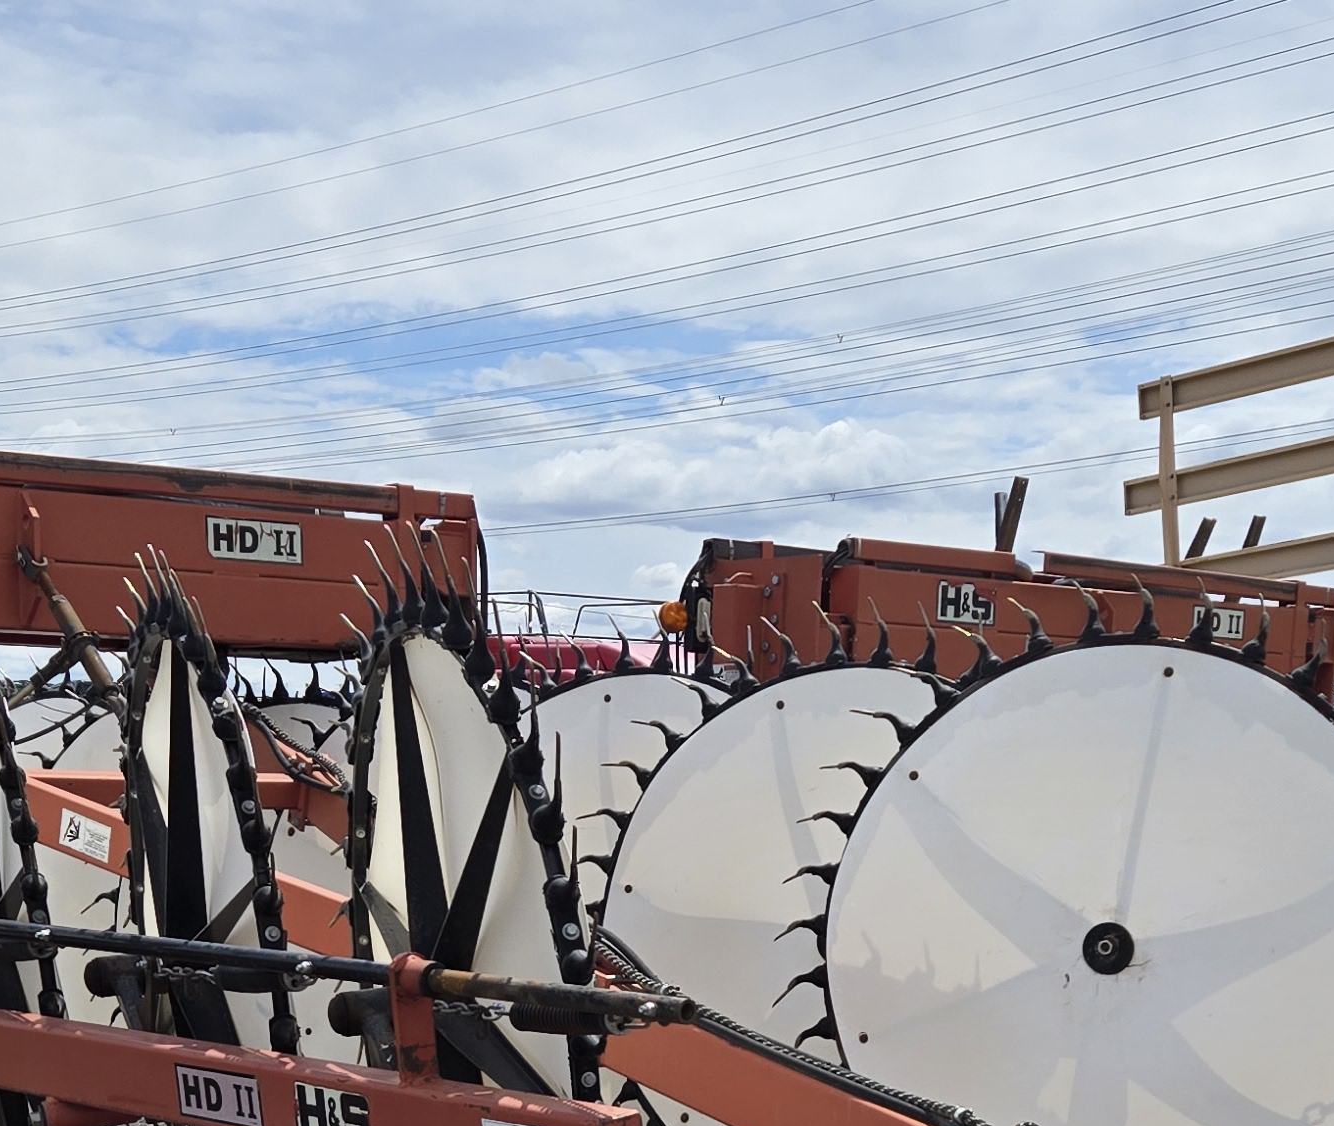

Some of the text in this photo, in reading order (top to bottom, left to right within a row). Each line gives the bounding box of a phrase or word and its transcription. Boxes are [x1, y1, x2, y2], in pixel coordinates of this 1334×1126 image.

[212, 522, 297, 557] HD II
[940, 585, 993, 620] H&S
[1227, 614, 1242, 635] II
[181, 1073, 258, 1120] HD II
